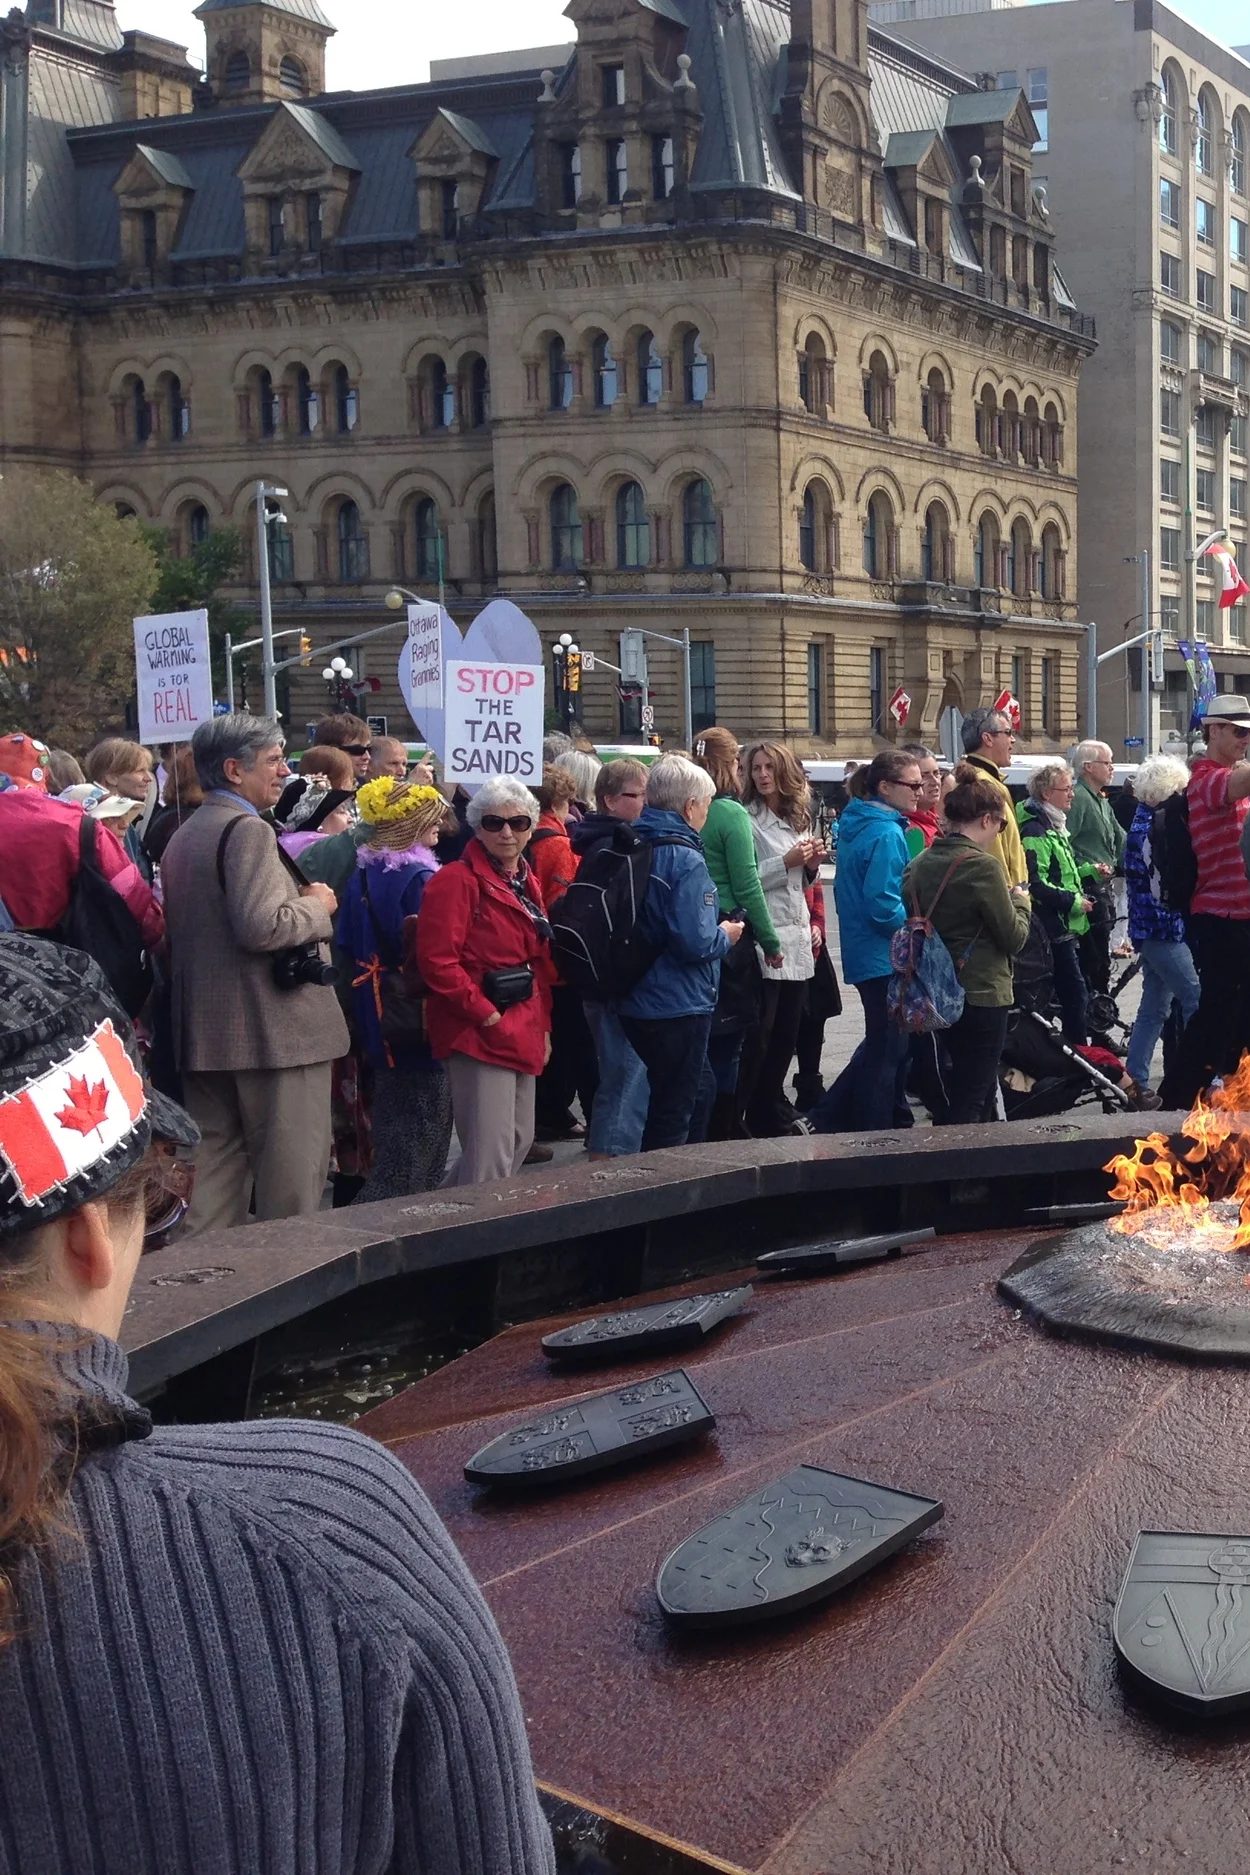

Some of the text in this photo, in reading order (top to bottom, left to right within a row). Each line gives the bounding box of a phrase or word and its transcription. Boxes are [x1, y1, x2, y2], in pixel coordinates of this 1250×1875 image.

[410, 614, 438, 637] Ottawa
[144, 627, 194, 651] GLOBAL
[411, 636, 439, 663] Raging
[147, 647, 197, 670] WARMING
[170, 673, 190, 686] FOR
[411, 663, 440, 688] Grannies
[457, 668, 535, 695] STOP
[153, 688, 198, 724] REAL
[475, 698, 513, 716] THE
[465, 719, 522, 744] TAR
[451, 747, 535, 776] SANDS
